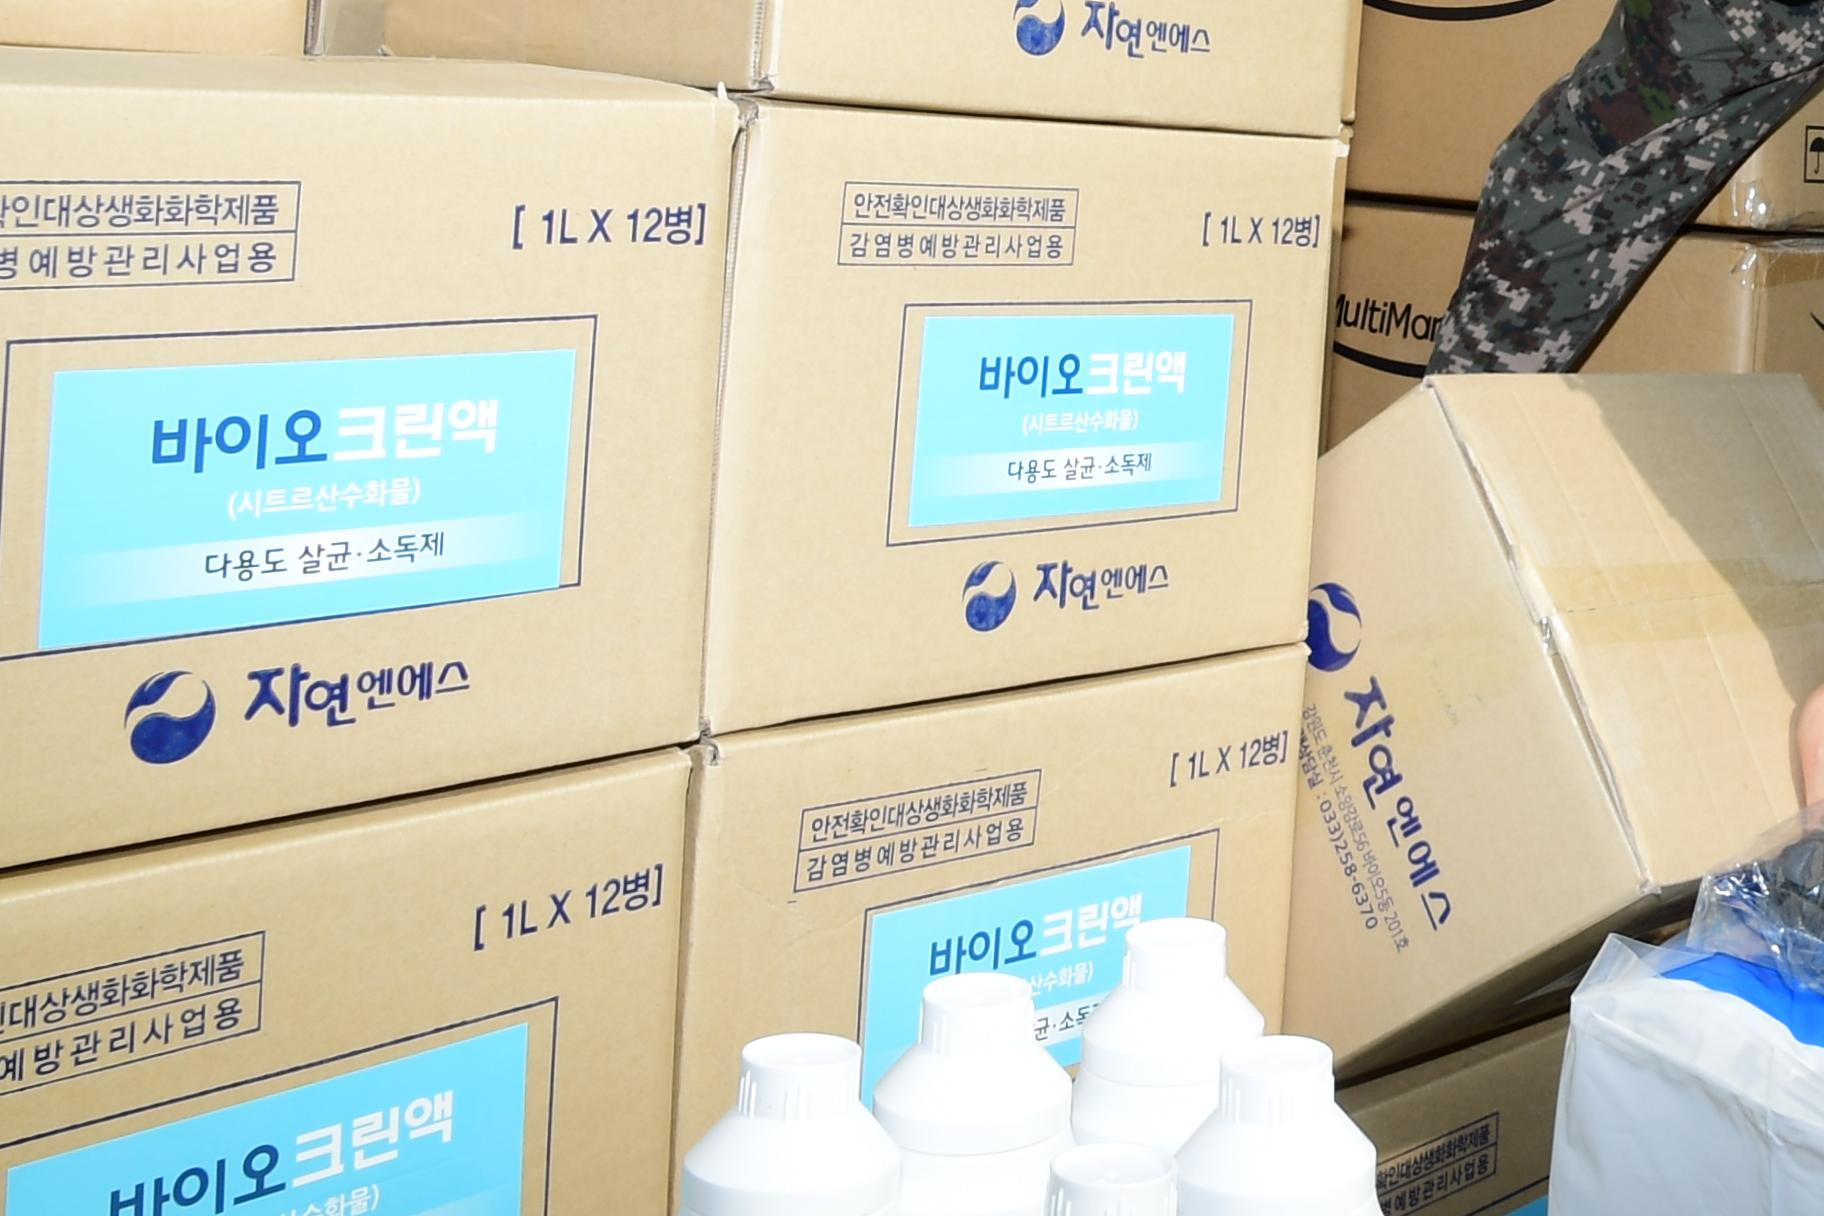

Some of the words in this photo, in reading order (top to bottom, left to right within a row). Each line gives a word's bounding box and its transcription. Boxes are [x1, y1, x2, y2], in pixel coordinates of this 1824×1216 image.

[1080, 0, 1212, 60] 자연엔에스
[978, 350, 1188, 400] 바이오크린액
[151, 397, 500, 475] 바이오크린액
[1007, 458, 1058, 485] 다용도
[205, 544, 290, 583] 다용도
[1033, 559, 1171, 612] 자연엔에스
[245, 660, 471, 729] 자연엔에스
[1343, 675, 1453, 932] 자연엔에스
[1384, 908, 1411, 954] 201호
[0, 948, 245, 1034] 대상생화화학제품
